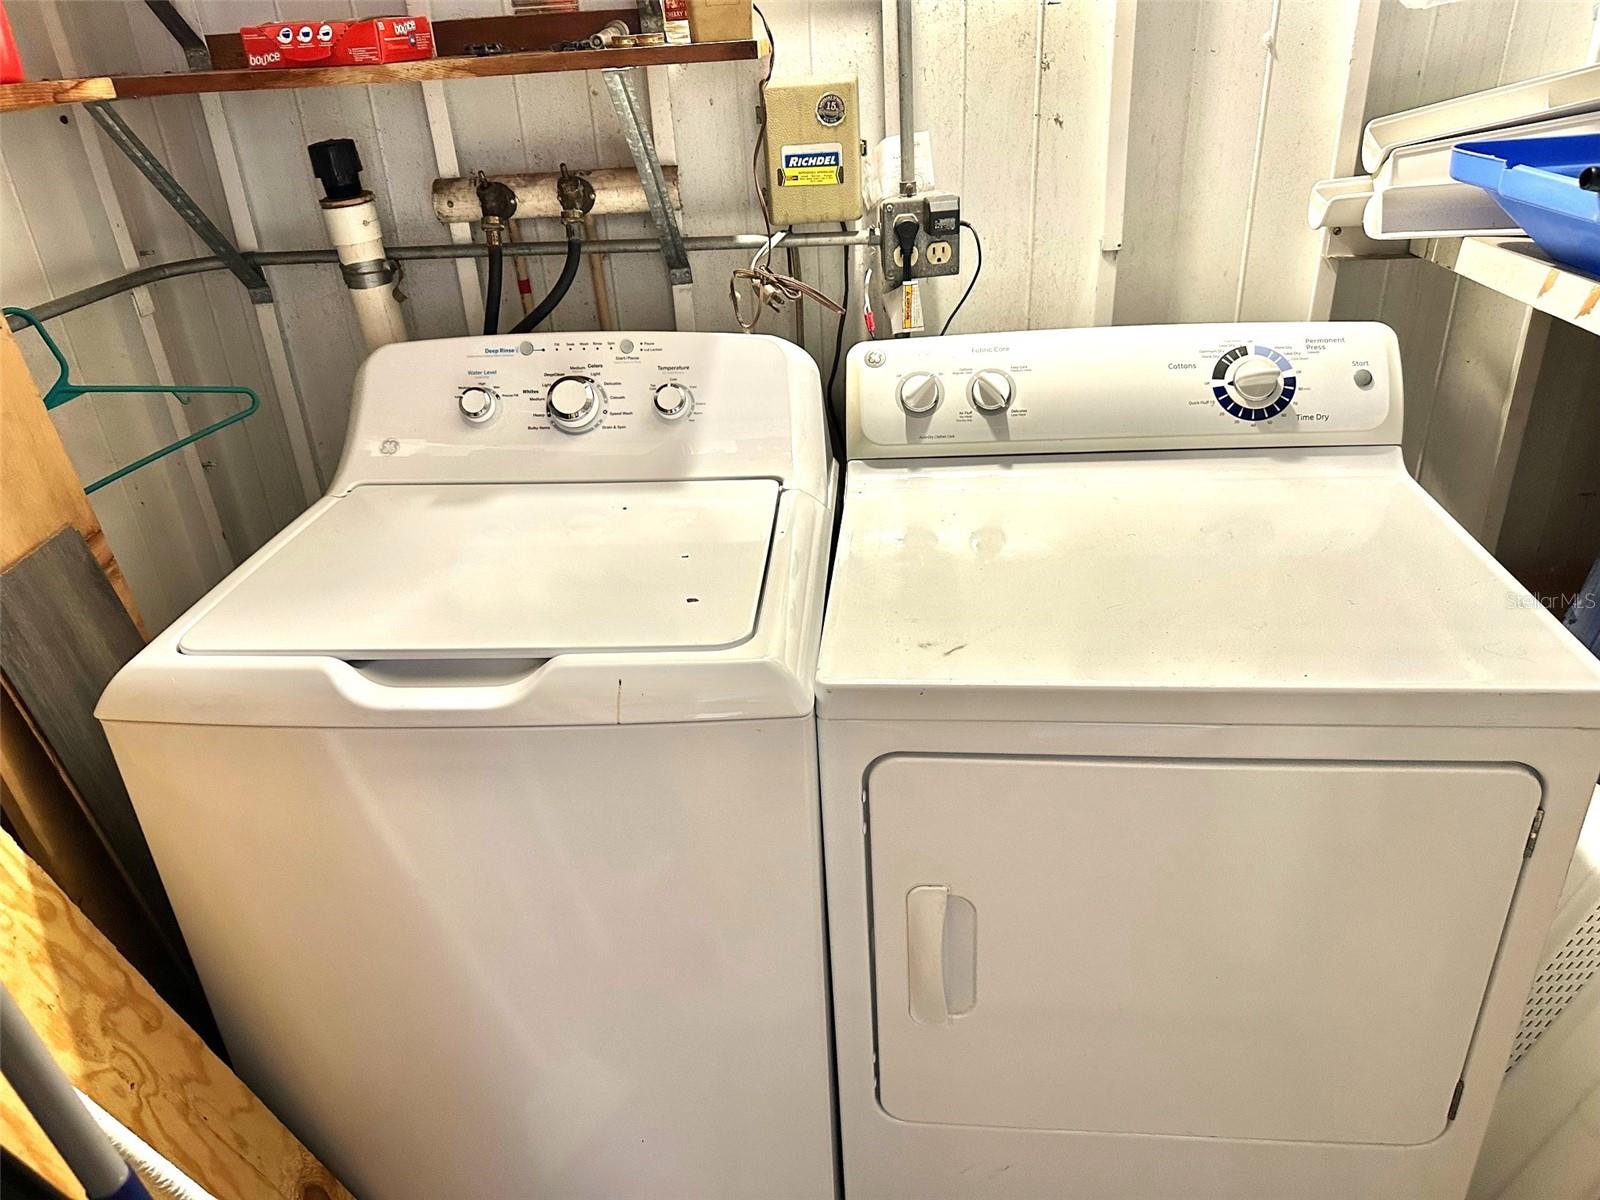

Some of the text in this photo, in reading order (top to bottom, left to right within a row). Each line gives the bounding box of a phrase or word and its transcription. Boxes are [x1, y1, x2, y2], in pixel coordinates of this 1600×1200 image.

[393, 20, 416, 35] bounce
[249, 52, 280, 66] bounce
[788, 155, 837, 168] RICHDEL
[1316, 413, 1330, 422] Dry
